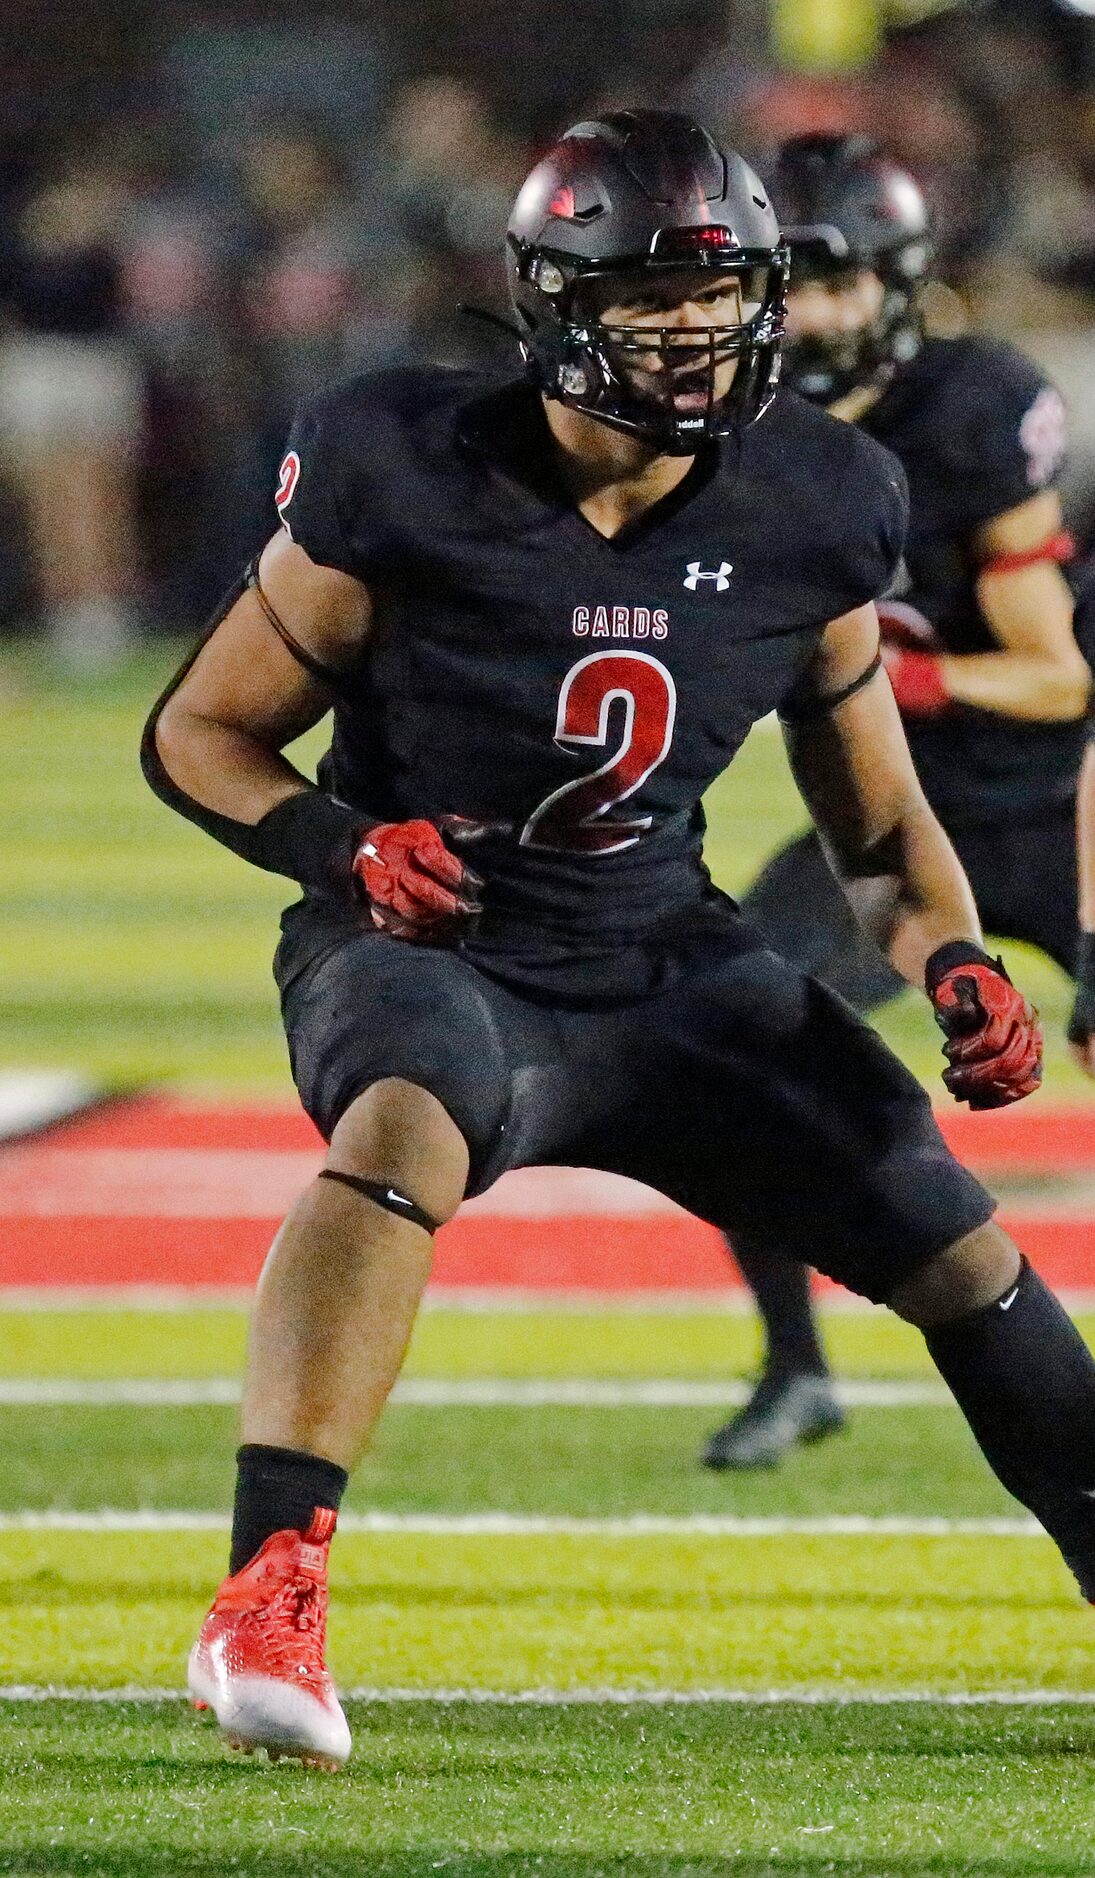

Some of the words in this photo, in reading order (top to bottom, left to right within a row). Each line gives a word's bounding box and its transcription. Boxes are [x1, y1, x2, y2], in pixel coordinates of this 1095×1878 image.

[275, 450, 301, 541] 2
[572, 605, 669, 640] CARDS
[519, 649, 677, 855] 2
